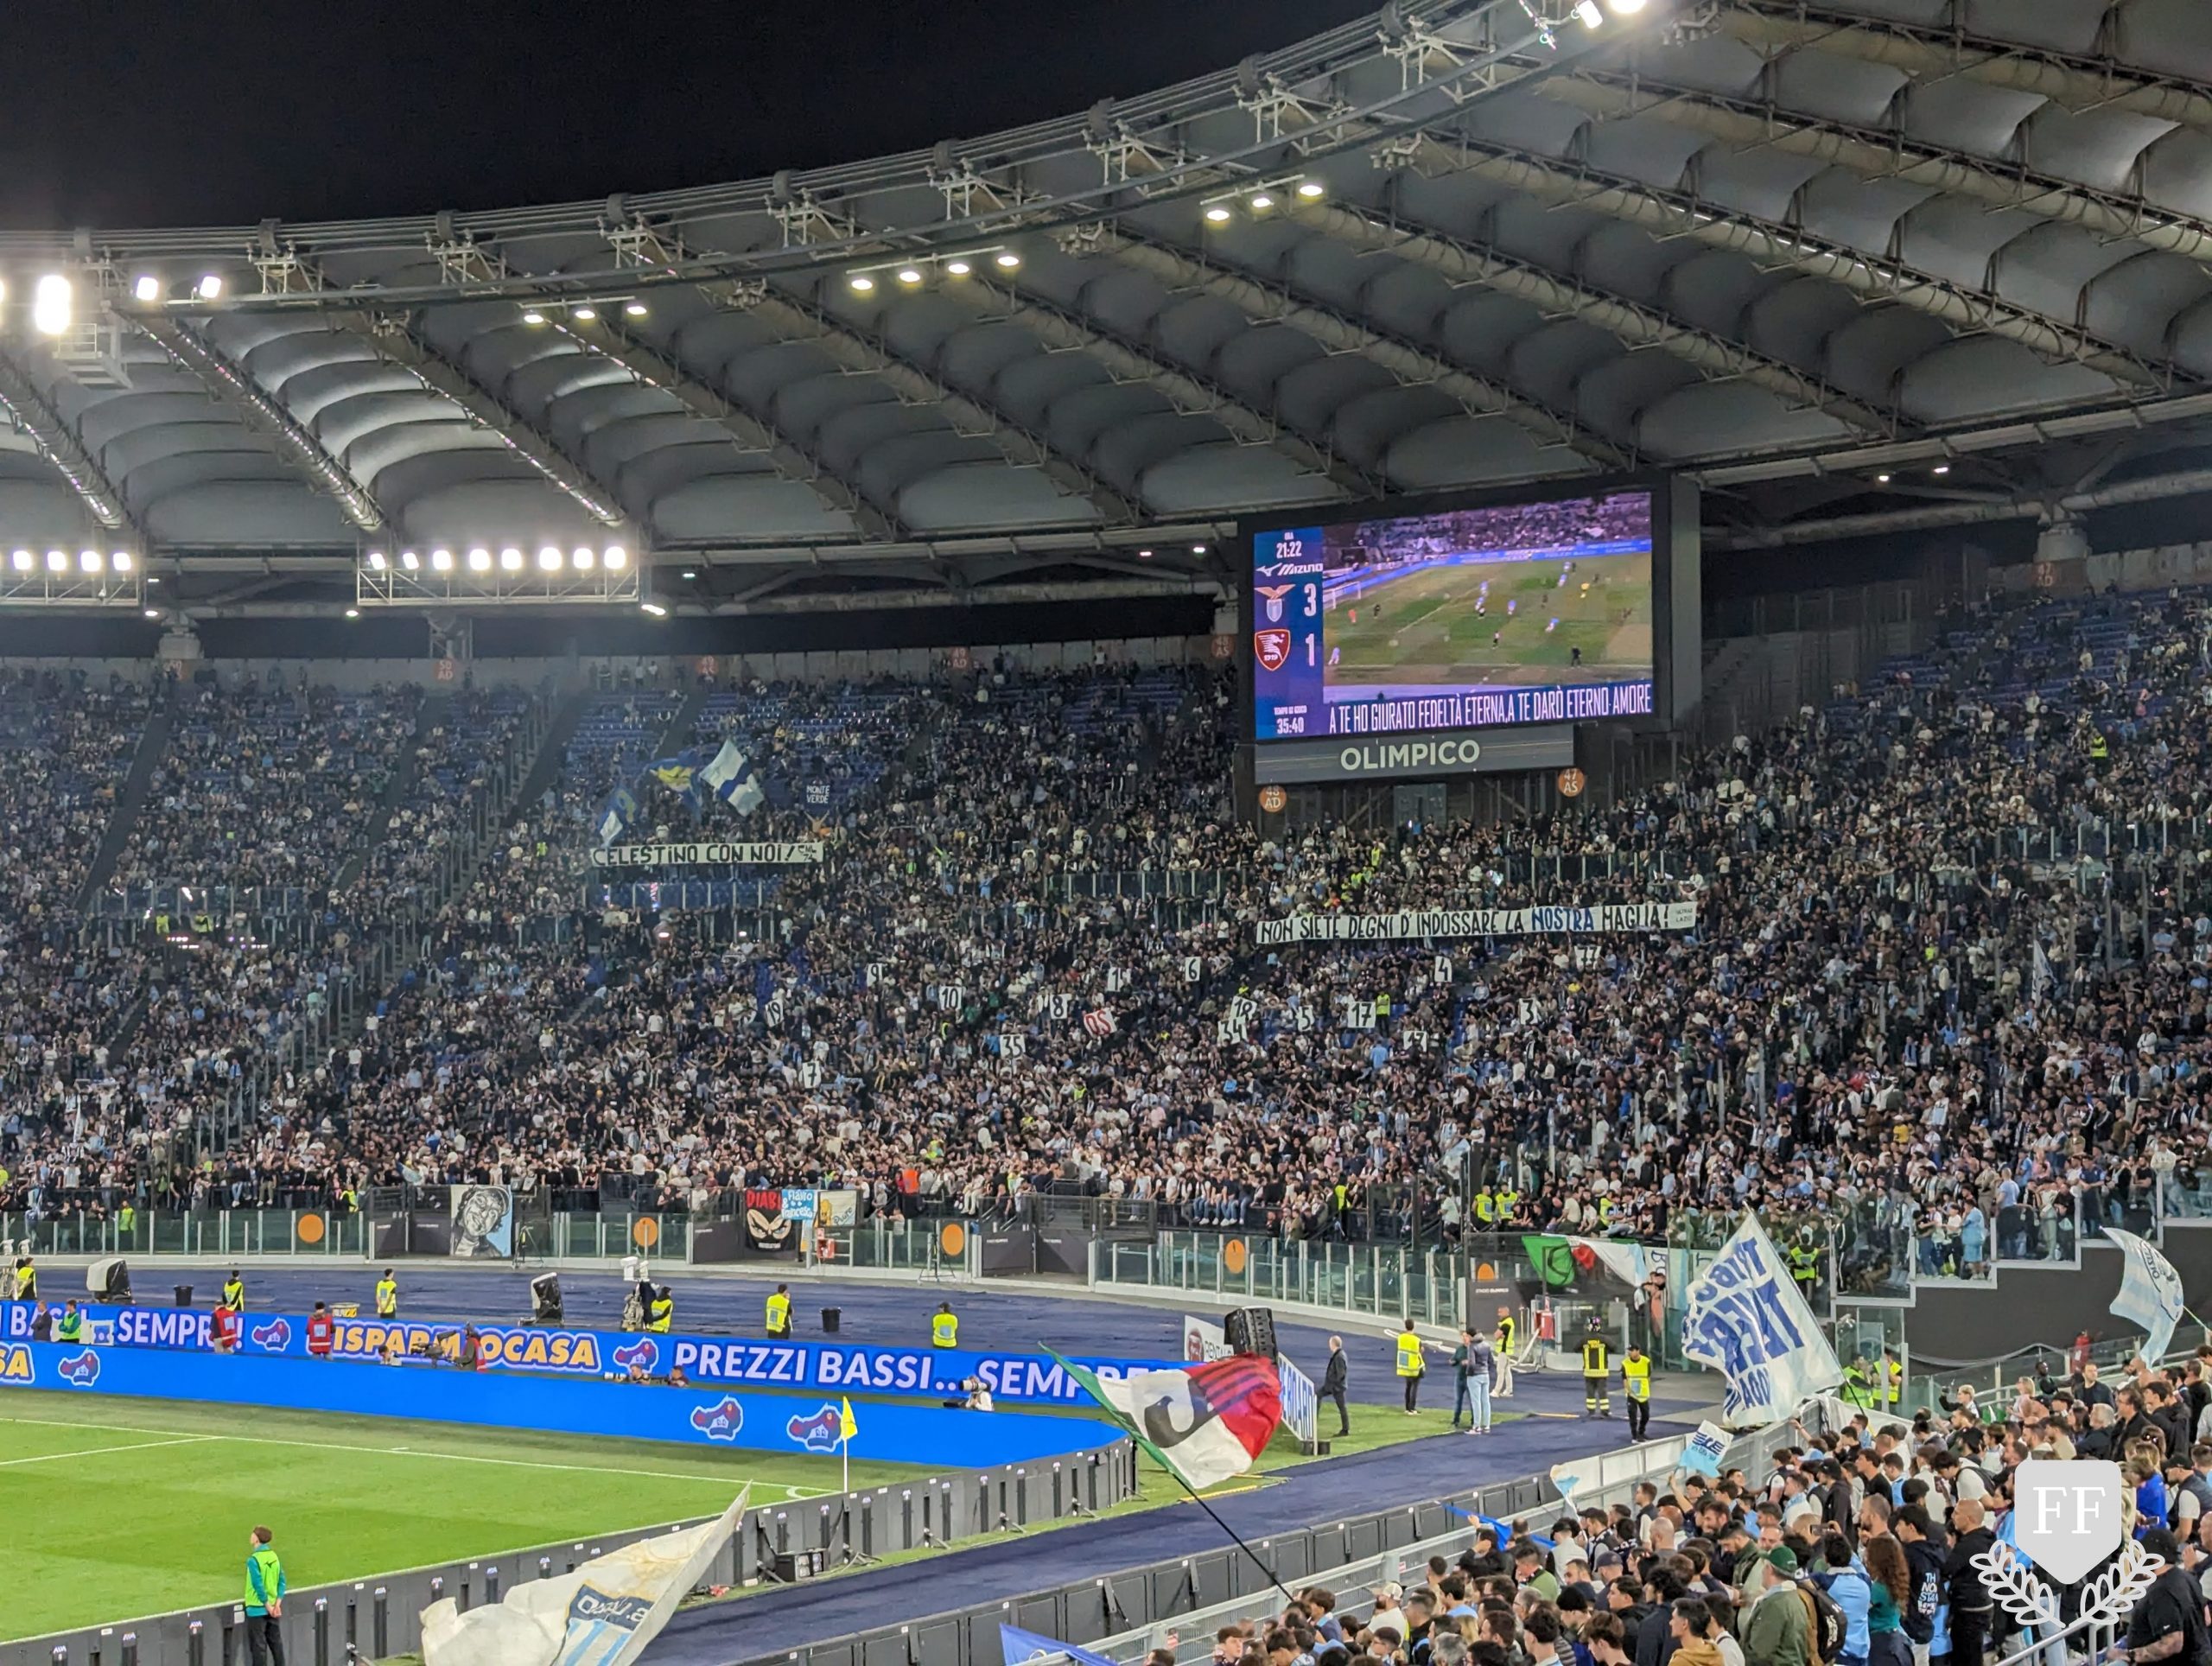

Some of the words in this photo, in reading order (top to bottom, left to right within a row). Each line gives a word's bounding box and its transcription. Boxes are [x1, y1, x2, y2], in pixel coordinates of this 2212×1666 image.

[1276, 541, 1302, 558] 21:22
[1303, 583, 1317, 617] 3
[1305, 633, 1315, 666] 1
[437, 670, 454, 680] AD
[1329, 707, 1337, 734] A
[1338, 705, 1351, 733] TE
[1353, 704, 1368, 732] HO
[1370, 700, 1415, 731] GIURATO
[1419, 693, 1462, 728] FEDELTÀ
[1518, 692, 1530, 721] TE
[1534, 685, 1564, 720] DARÒ
[1567, 687, 1609, 718] ETERNO
[1612, 684, 1652, 714] AMORE
[1277, 716, 1305, 734] 35:40
[1340, 740, 1480, 771] OLIMPICO
[1563, 769, 1577, 780] 47
[806, 785, 830, 795] MONTE
[1563, 780, 1578, 792] AS
[806, 795, 830, 804] VERDE
[1264, 797, 1281, 808] AD
[593, 844, 698, 865] CELESTINO
[706, 844, 743, 863] CON
[1261, 919, 1294, 943] NON
[1300, 915, 1339, 938] SIETE
[1348, 914, 1394, 938] DEGNI
[1505, 910, 1524, 934] LA
[1531, 907, 1594, 931] NOSTRA
[1580, 946, 1598, 965] 77
[871, 963, 880, 984] 9
[1188, 958, 1198, 980] 6
[1438, 958, 1448, 981] 4
[942, 988, 959, 1009] 10
[1052, 995, 1064, 1018] 8
[767, 1002, 781, 1024] 19
[1234, 999, 1252, 1021] 18
[1301, 1007, 1312, 1030] 5
[1351, 1002, 1373, 1027] 17
[1522, 999, 1534, 1025] 3
[1221, 1019, 1243, 1042] 34
[1003, 1036, 1023, 1059] 35
[807, 1063, 817, 1086] 7
[747, 1190, 782, 1211] DIAB
[118, 1310, 244, 1349] SEMPR!
[333, 1326, 595, 1366] ISPARMOCASA
[676, 1342, 805, 1381] PREZZI
[817, 1352, 957, 1389] BASSI..
